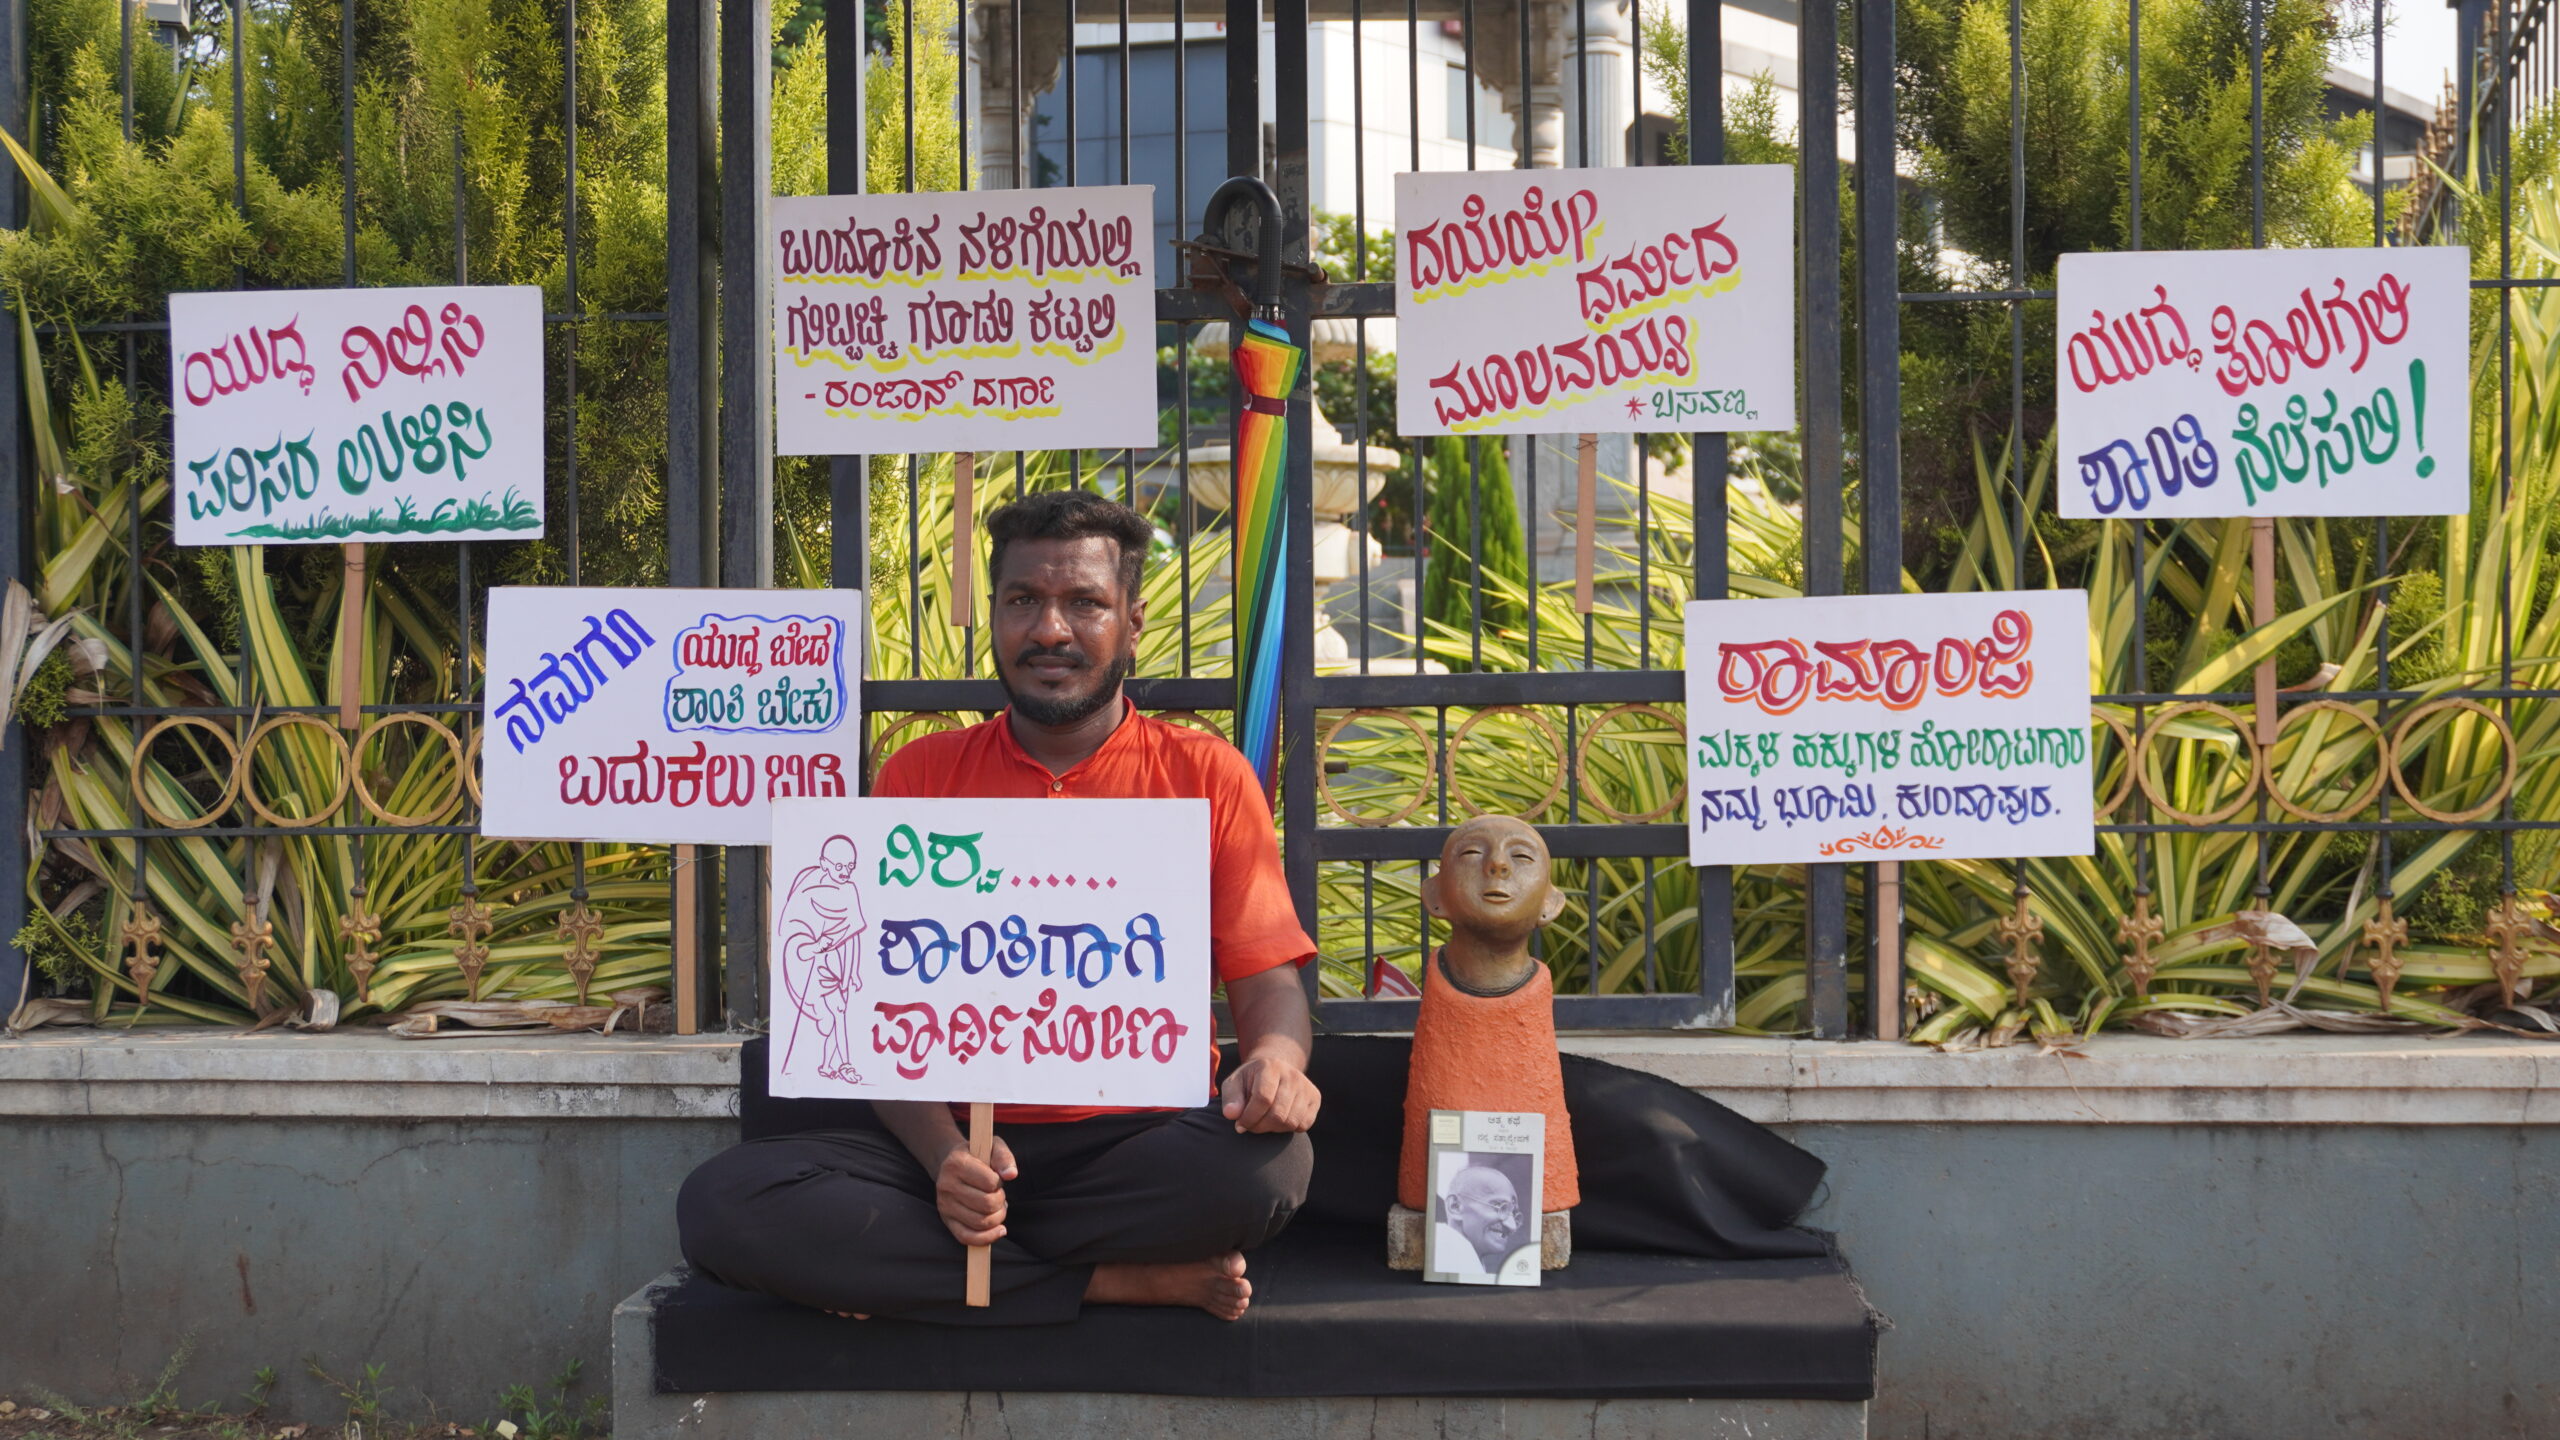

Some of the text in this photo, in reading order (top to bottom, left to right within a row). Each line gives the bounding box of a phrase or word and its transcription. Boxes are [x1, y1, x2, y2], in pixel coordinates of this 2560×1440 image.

[781, 207, 1140, 279] ಬಂದೂಕಿನ ನಳಿಗೆಯಲ್ಲಿ
[1576, 214, 1739, 325] ಧರ್ಮದ
[184, 303, 484, 406] ಯುದ್ಧ ನಿಲ್ಲಿಸಿ
[788, 290, 1115, 360] ಗುಬ್ಬಚ್ಚಿ ಗೂಡು ಕಟ್ಟಲಿ
[2068, 273, 2411, 397] ಯುದ್ಧ ತೊಲಗಲಿ
[973, 377, 1054, 409] ದರ್ಗಾ
[1652, 388, 1758, 423] ಬಸವಣ್ಣ
[188, 398, 491, 524] ಪರಿಸರ ಉಳಿಸಿ
[2079, 415, 2217, 514] ಶಾಂತಿ
[682, 618, 832, 676] ಯುದ್ಧ ಬೇಡ
[1718, 610, 2033, 712] ರಾಮಾಂಜಿ
[672, 676, 832, 725] ಶಾಂತಿ ಬೇಕು
[559, 740, 755, 807] ಬದುಕಲು
[1699, 721, 2083, 777] ಮಕ್ಕಳ ಹಕ್ಕುಗಳ ಹೋರಾಟಗಾರ
[1701, 786, 1767, 833] ನಮ್ಮ
[878, 913, 1164, 992] ಶಾಂತಿಗಾಗಿ
